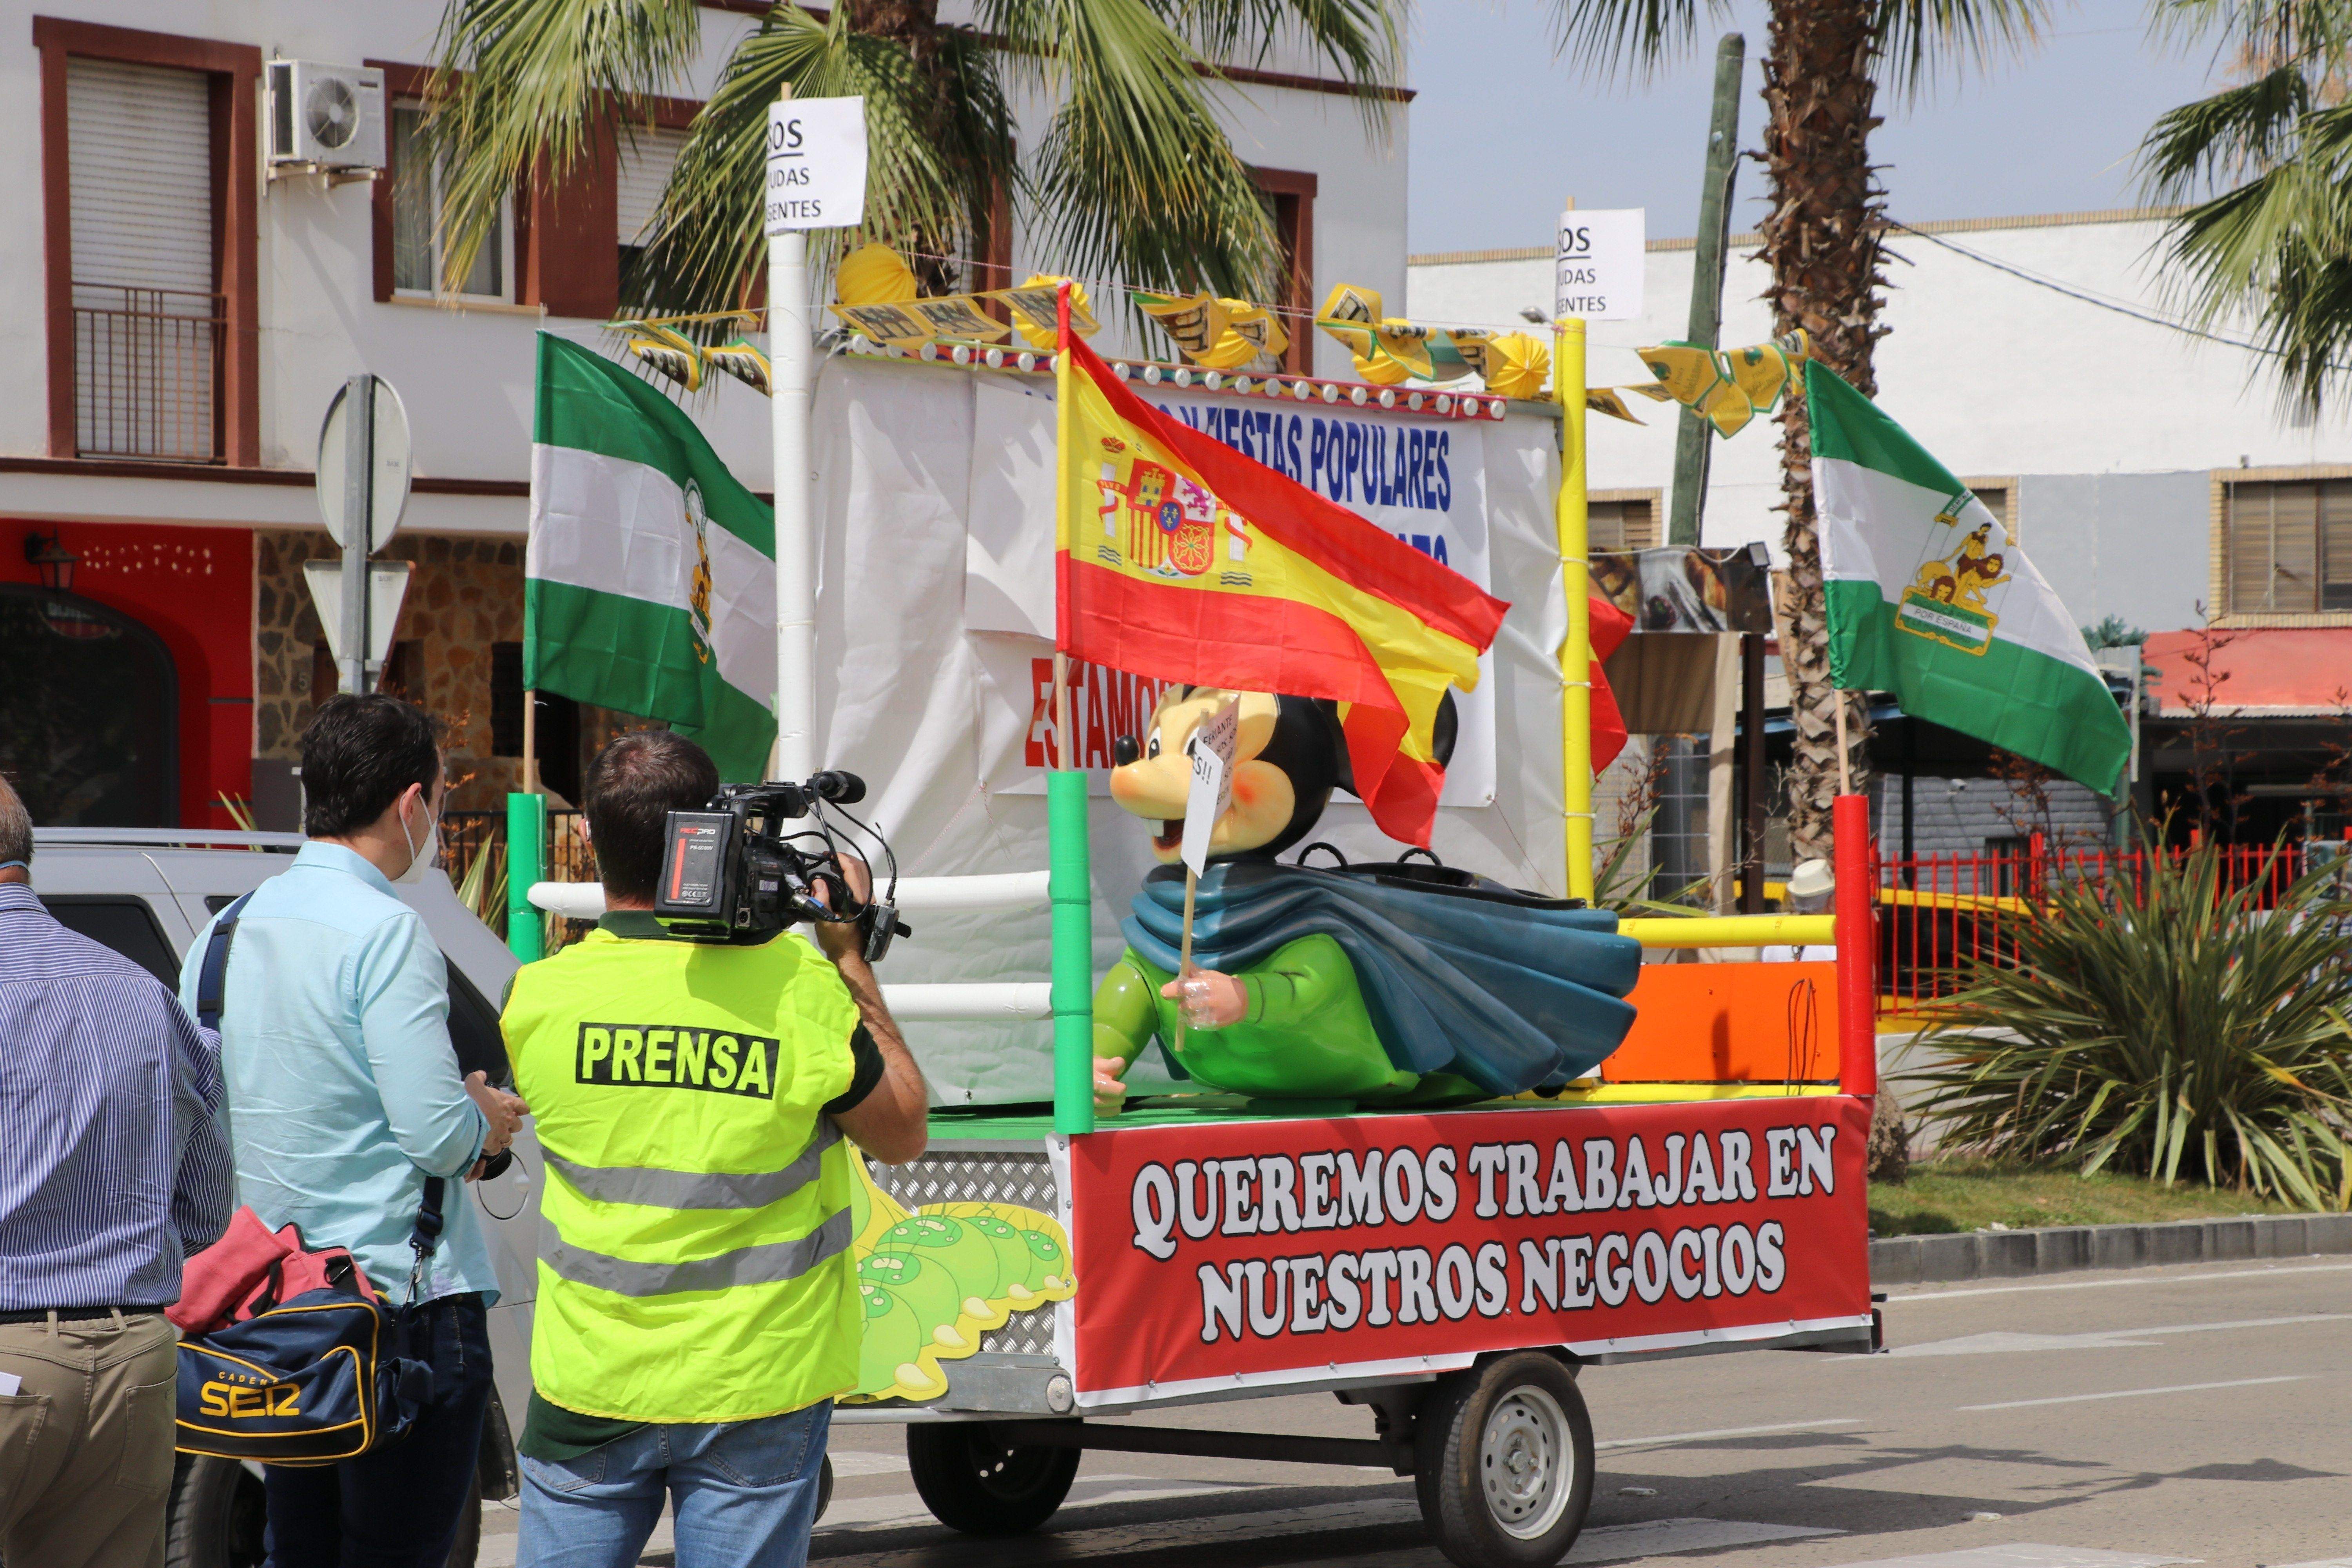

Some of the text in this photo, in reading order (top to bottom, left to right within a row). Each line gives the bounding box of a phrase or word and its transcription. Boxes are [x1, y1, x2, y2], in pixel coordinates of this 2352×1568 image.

[1310, 417, 1452, 513] POPULARES
[1914, 608, 1935, 621] POR
[1025, 658, 1176, 769] ESTAMO
[583, 1027, 769, 1094] PRENSA
[1131, 1123, 1837, 1262] QUEREMOS TRABAJAR EN
[1196, 1219, 1787, 1345] NUESTROS NEGOCIOS
[199, 1380, 301, 1419] SER
